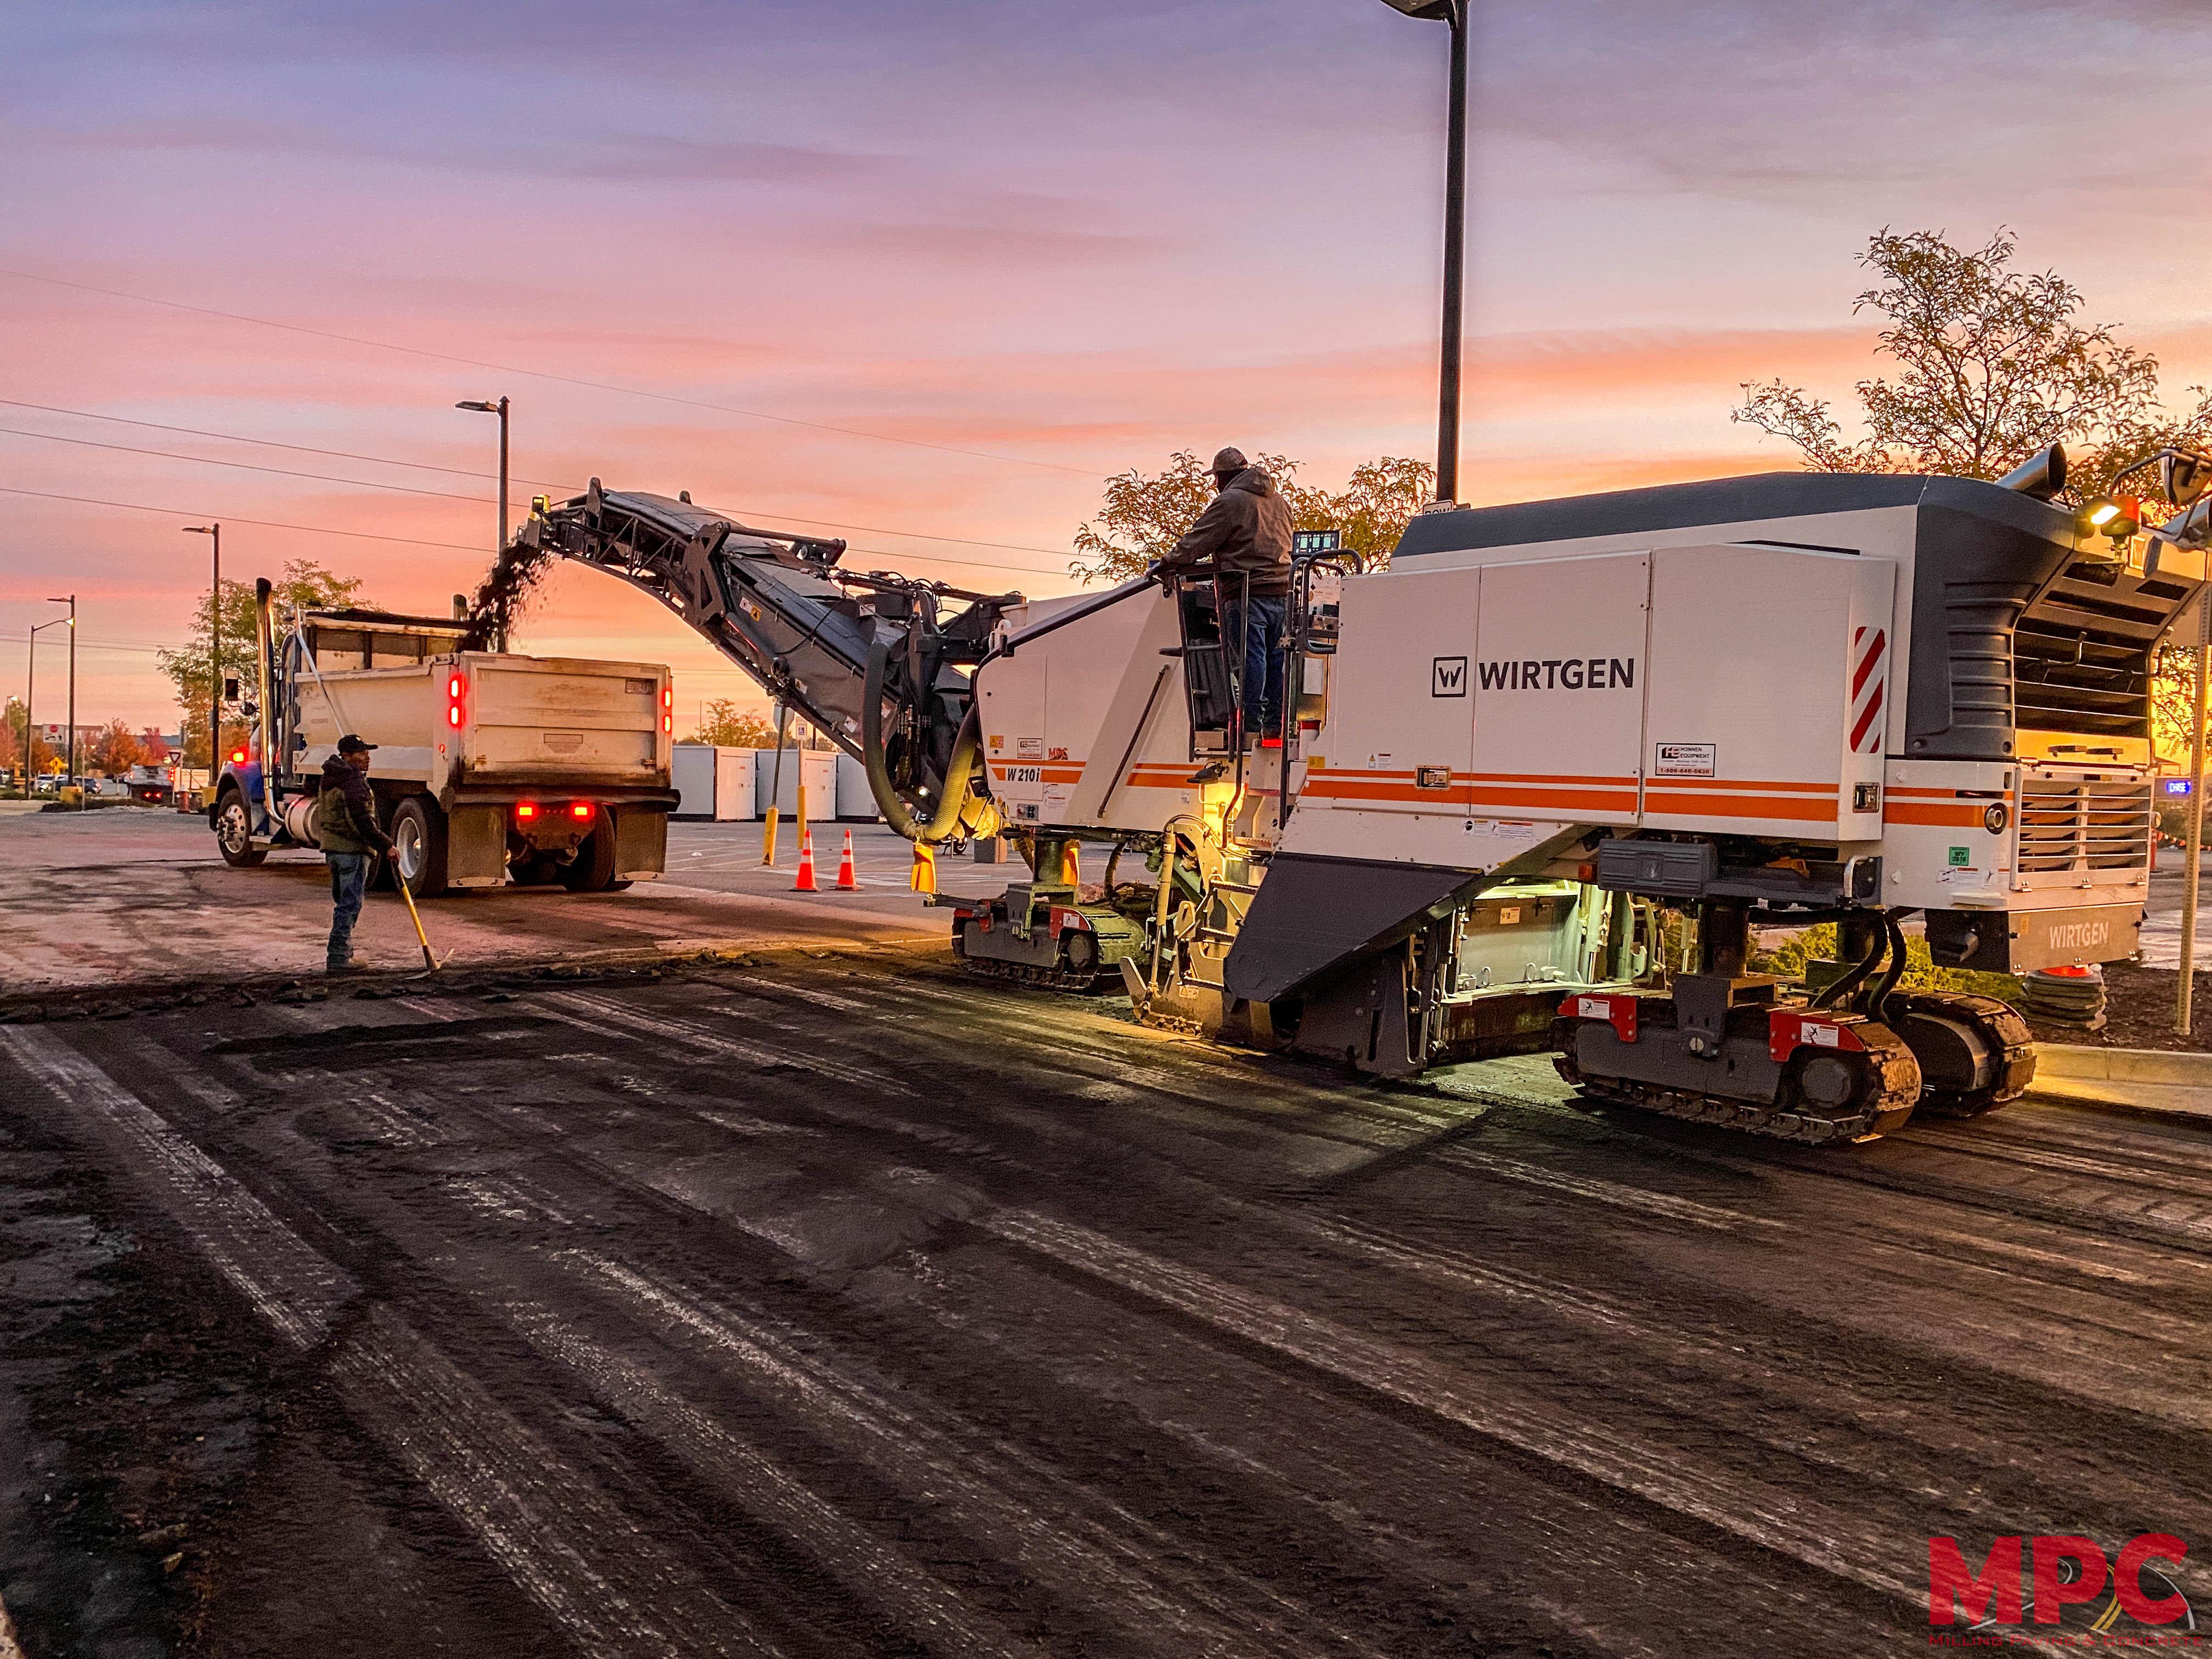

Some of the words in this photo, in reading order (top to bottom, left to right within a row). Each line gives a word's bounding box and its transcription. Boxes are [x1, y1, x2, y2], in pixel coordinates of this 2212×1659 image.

[1479, 658, 1634, 690] WIRTGEN
[1007, 768, 1017, 782] W
[2050, 922, 2109, 950] WIRTGEN
